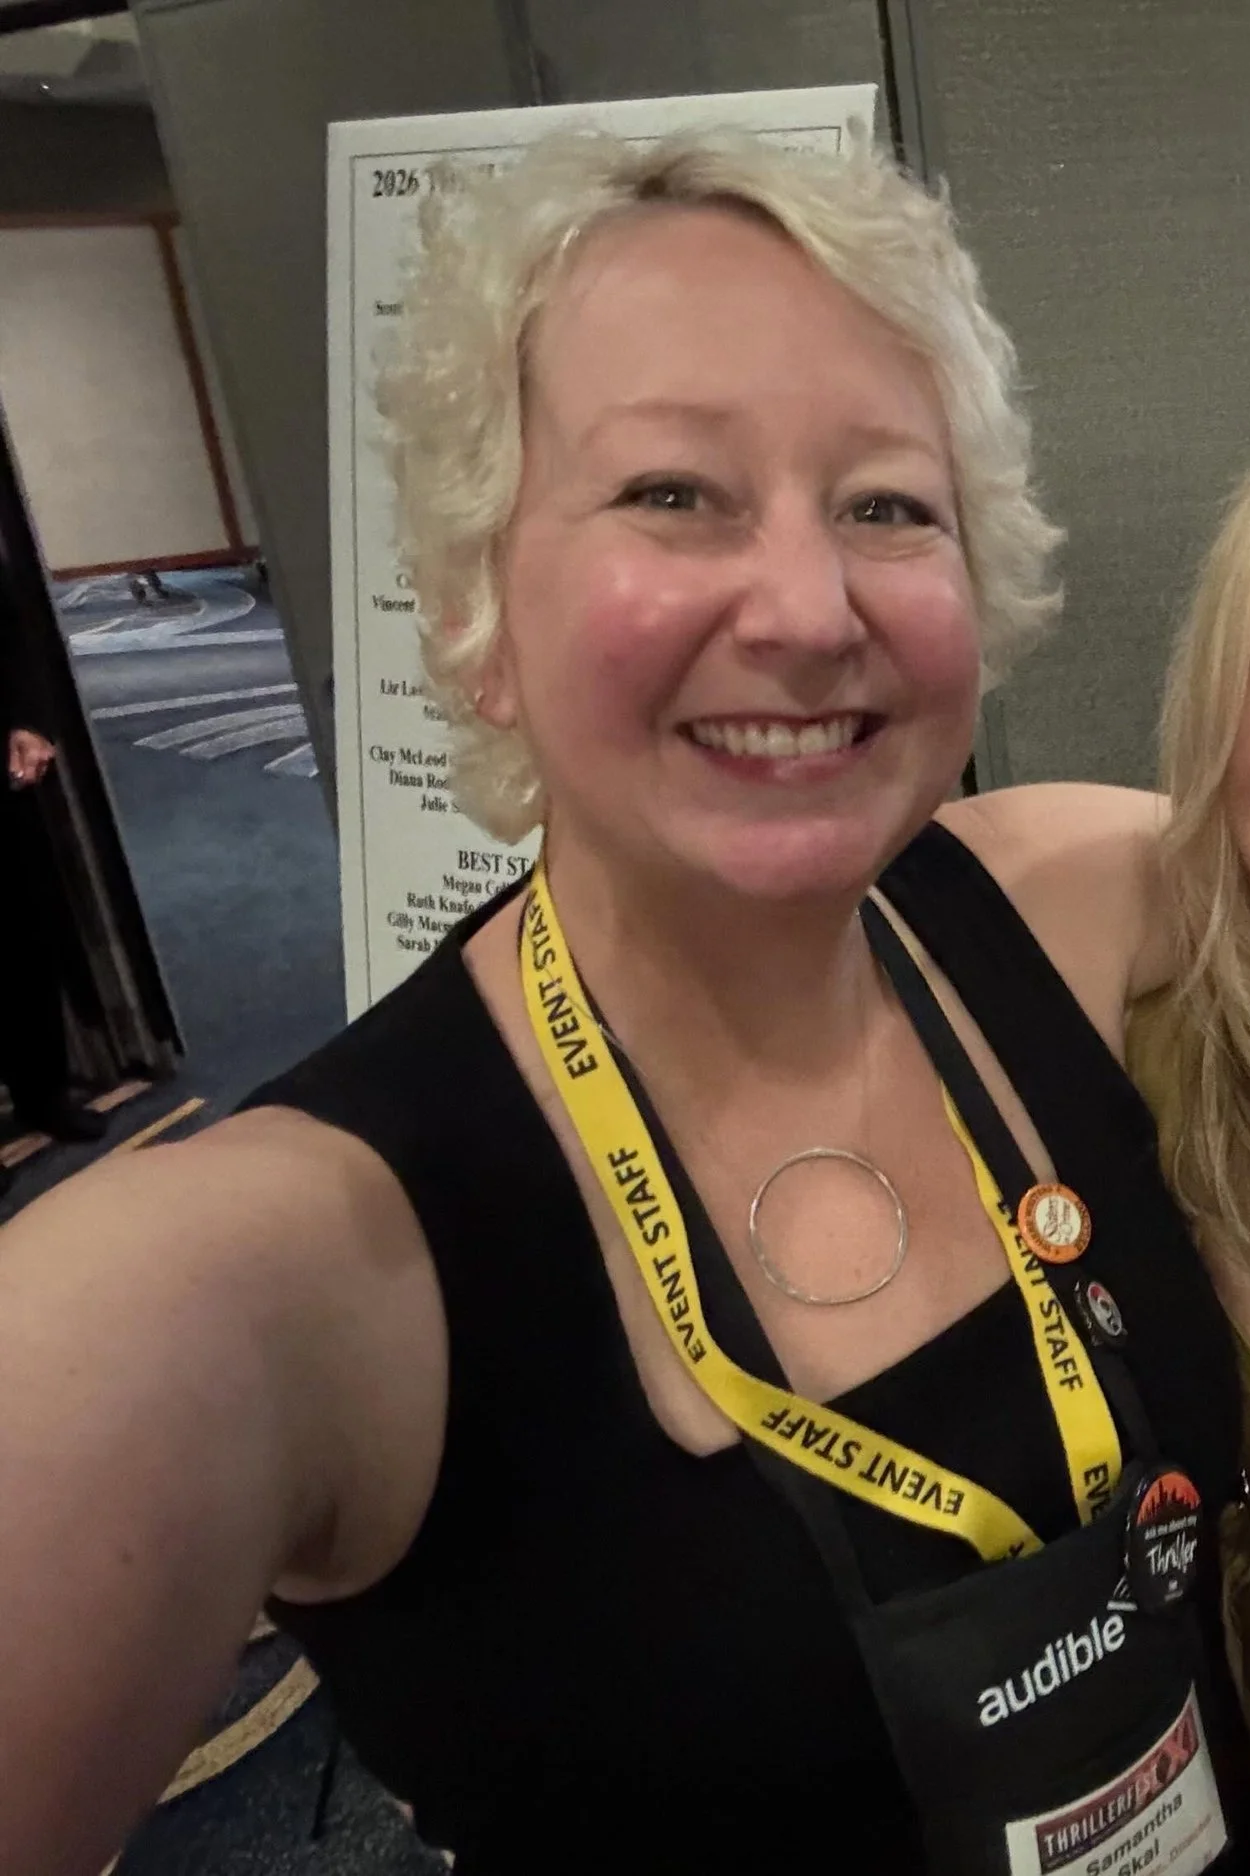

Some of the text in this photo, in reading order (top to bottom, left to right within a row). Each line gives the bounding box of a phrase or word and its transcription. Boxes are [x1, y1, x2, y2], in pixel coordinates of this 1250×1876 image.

[373, 168, 420, 197] 2026
[370, 746, 446, 767] Clay McLeod
[389, 769, 423, 788] Diana
[421, 794, 448, 812] Julie
[458, 850, 503, 874] BEST
[442, 874, 482, 897] Megan
[406, 892, 436, 910] Ruth
[387, 911, 414, 933] Gilly
[397, 934, 430, 951] Sarah
[539, 975, 599, 1080] EVENT
[607, 1147, 707, 1365] EVENT STAFF
[1039, 1298, 1084, 1392] STAFF
[760, 1408, 965, 1516] EVENT STAFF
[1146, 1531, 1198, 1575] Thriller
[977, 1612, 1126, 1728] audible
[1086, 1793, 1183, 1876] Samantha
